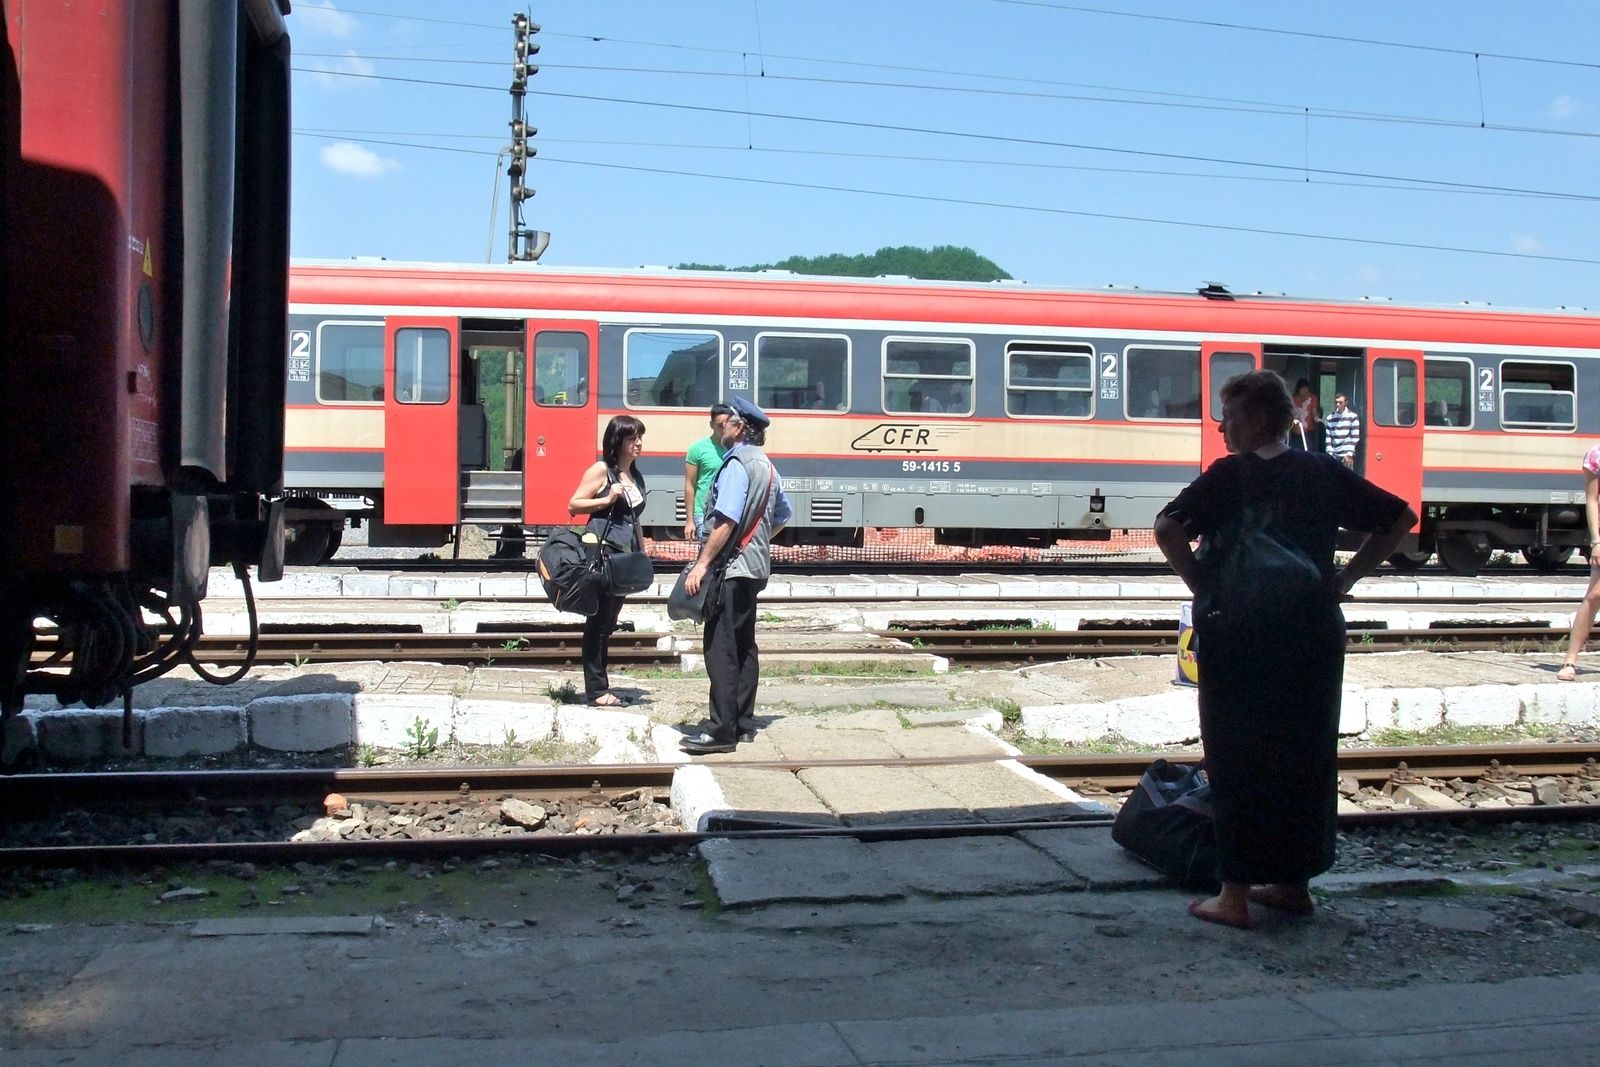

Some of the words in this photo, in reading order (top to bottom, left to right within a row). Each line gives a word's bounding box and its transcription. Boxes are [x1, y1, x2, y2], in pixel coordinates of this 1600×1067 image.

[292, 332, 309, 357] 2
[731, 343, 747, 367] 2
[1102, 354, 1117, 377] 2
[1480, 369, 1493, 391] 2
[883, 428, 930, 445] CFR
[902, 461, 949, 472] 59-1415
[953, 462, 961, 472] 5
